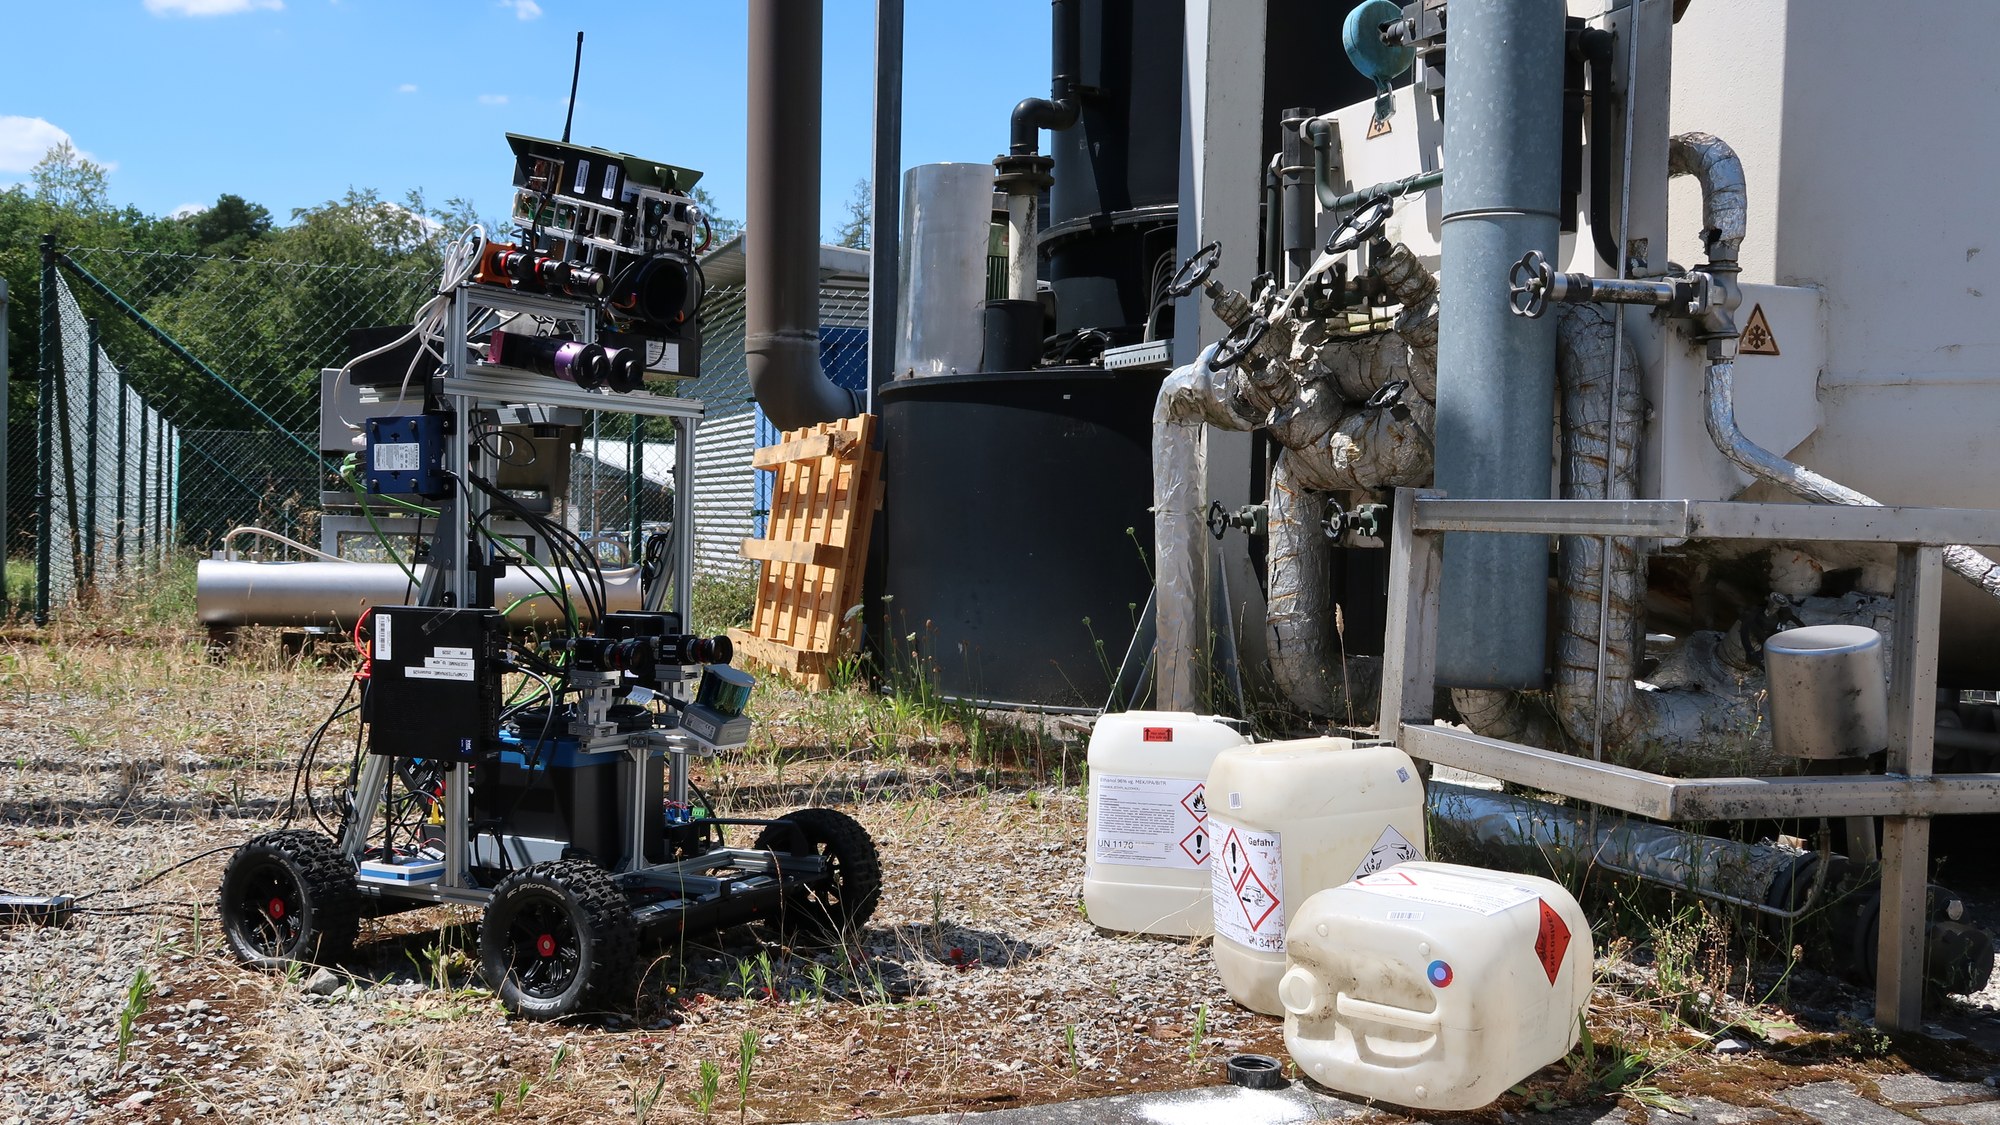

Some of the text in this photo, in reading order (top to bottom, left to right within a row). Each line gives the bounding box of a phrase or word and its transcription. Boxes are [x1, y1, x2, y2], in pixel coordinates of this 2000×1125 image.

[1097, 839, 1134, 850] UN 1170
[1248, 837, 1275, 847] Gefahr
[519, 882, 566, 900] Pioneer
[1259, 937, 1284, 950] 3412
[1544, 910, 1555, 974] EXPLOSIVES
